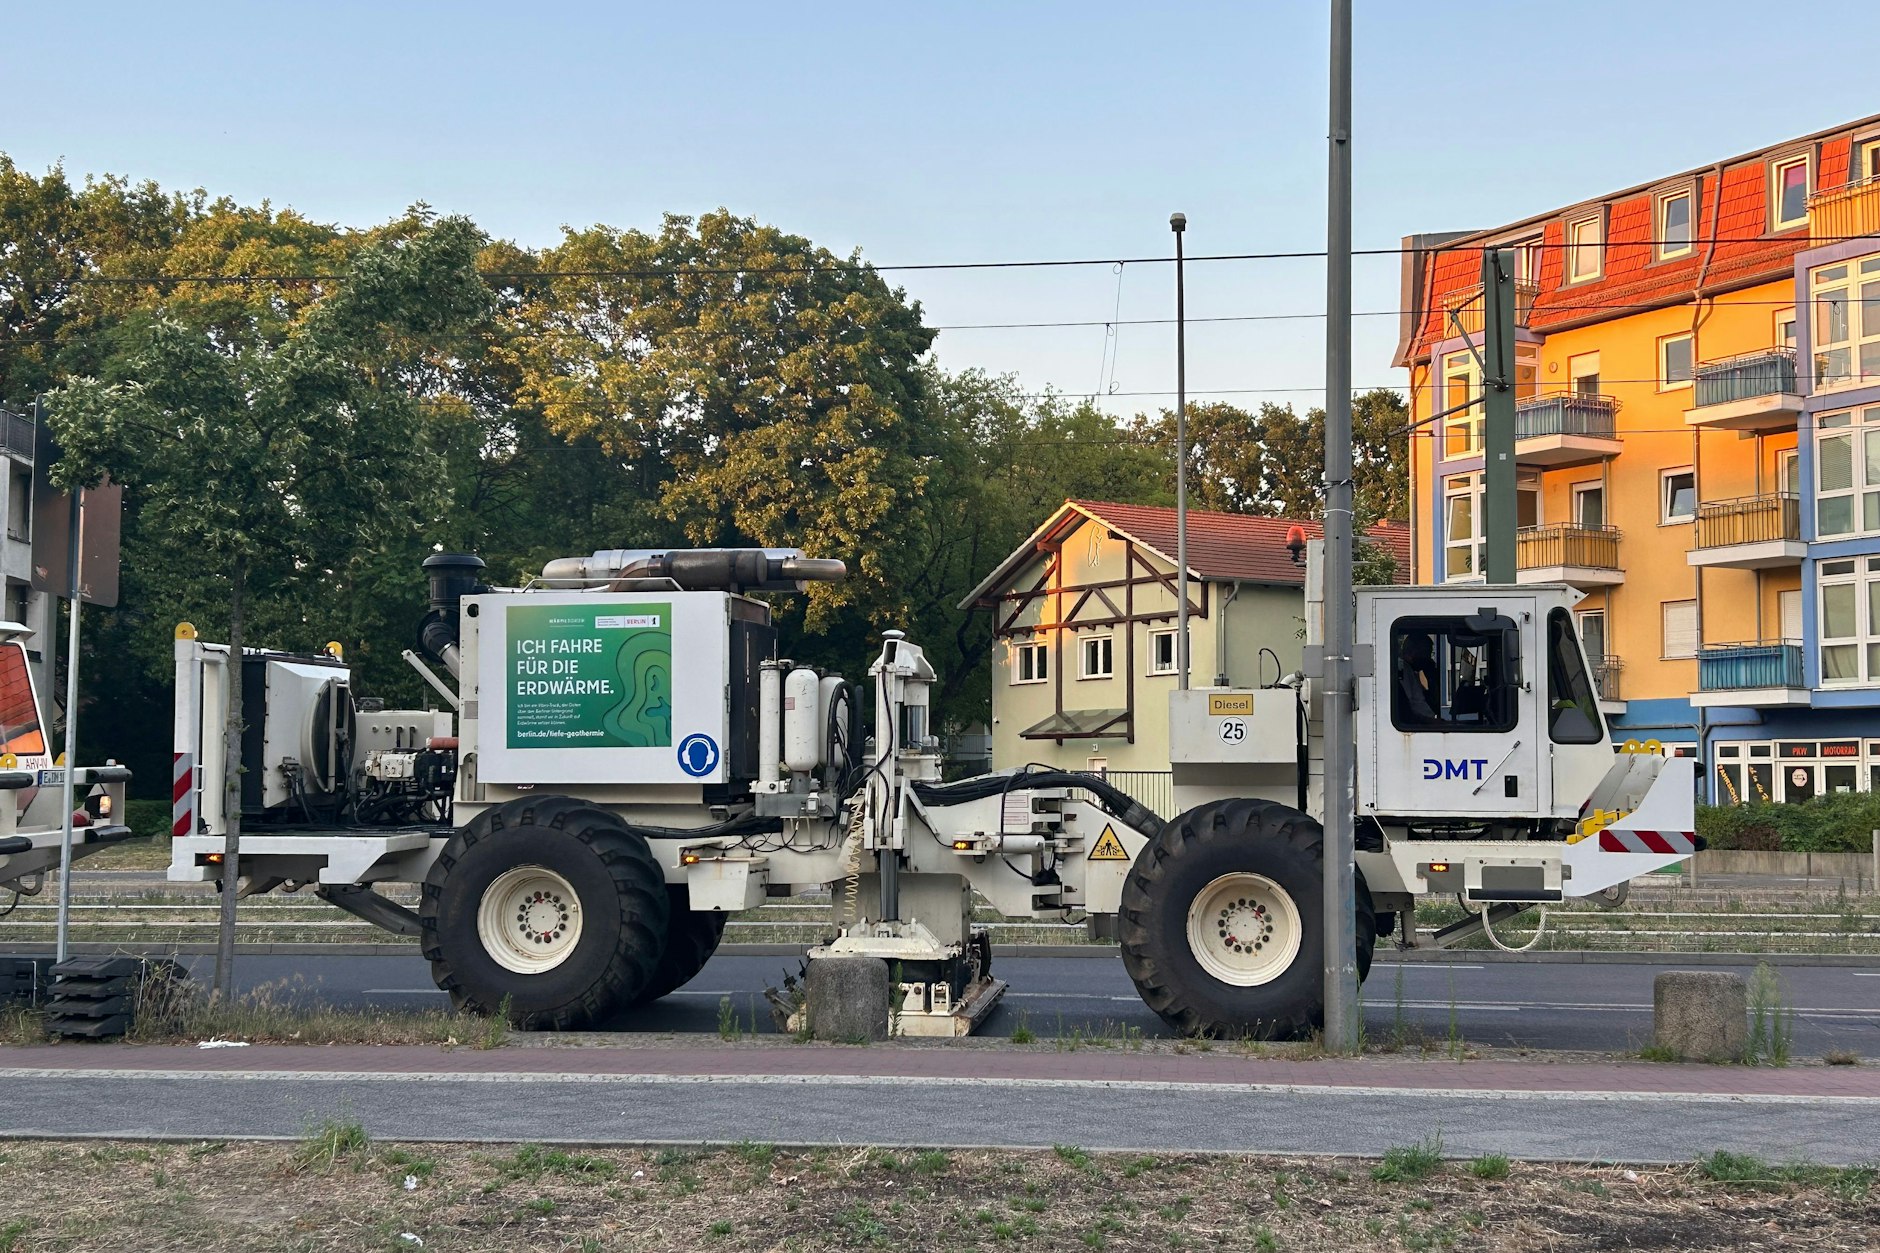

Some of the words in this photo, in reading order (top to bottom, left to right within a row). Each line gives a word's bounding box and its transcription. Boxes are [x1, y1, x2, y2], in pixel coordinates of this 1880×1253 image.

[517, 639, 546, 654] ICH
[550, 638, 603, 654] FAHRE
[517, 656, 548, 675] FÜR
[552, 659, 579, 674] DIE
[517, 676, 615, 695] ERDWÄRME.
[1214, 700, 1249, 709] Diesel
[1222, 722, 1244, 740] 25
[1792, 746, 1808, 756] PKW
[1823, 745, 1857, 756] MOTORRAD
[1423, 759, 1489, 780] DMT
[1717, 764, 1740, 806] FAHRSCHU
